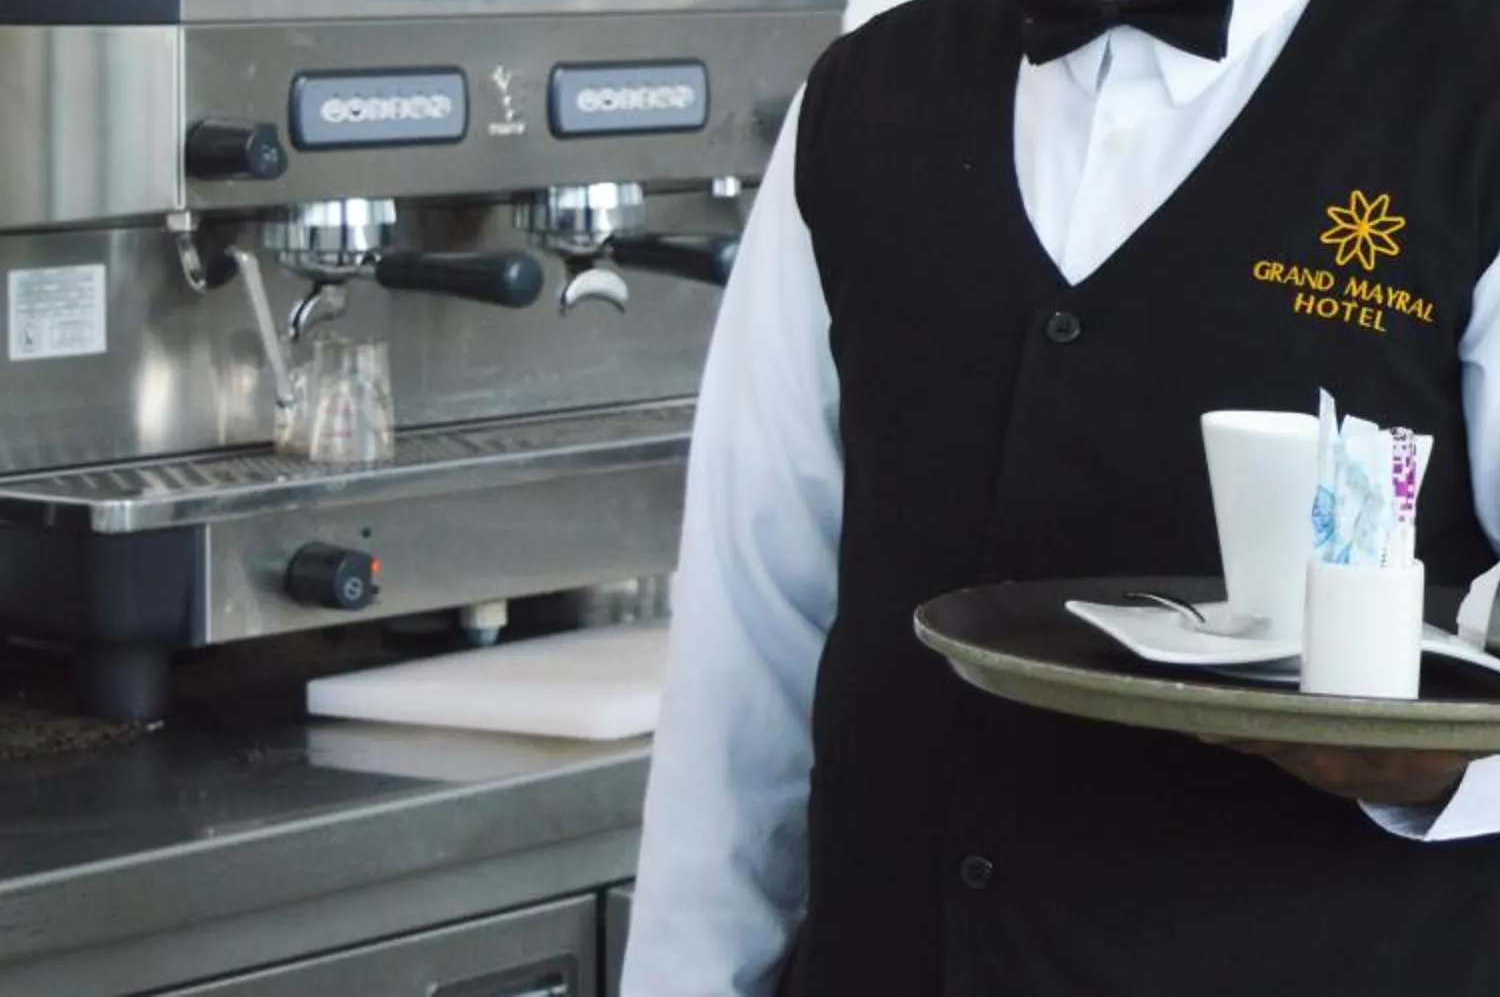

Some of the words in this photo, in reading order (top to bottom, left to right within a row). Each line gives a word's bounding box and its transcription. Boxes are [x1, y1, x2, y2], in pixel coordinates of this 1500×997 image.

[1253, 260, 1335, 291] GRAND
[1344, 276, 1434, 322] MAYRAL
[1294, 292, 1386, 331] HOTEL
